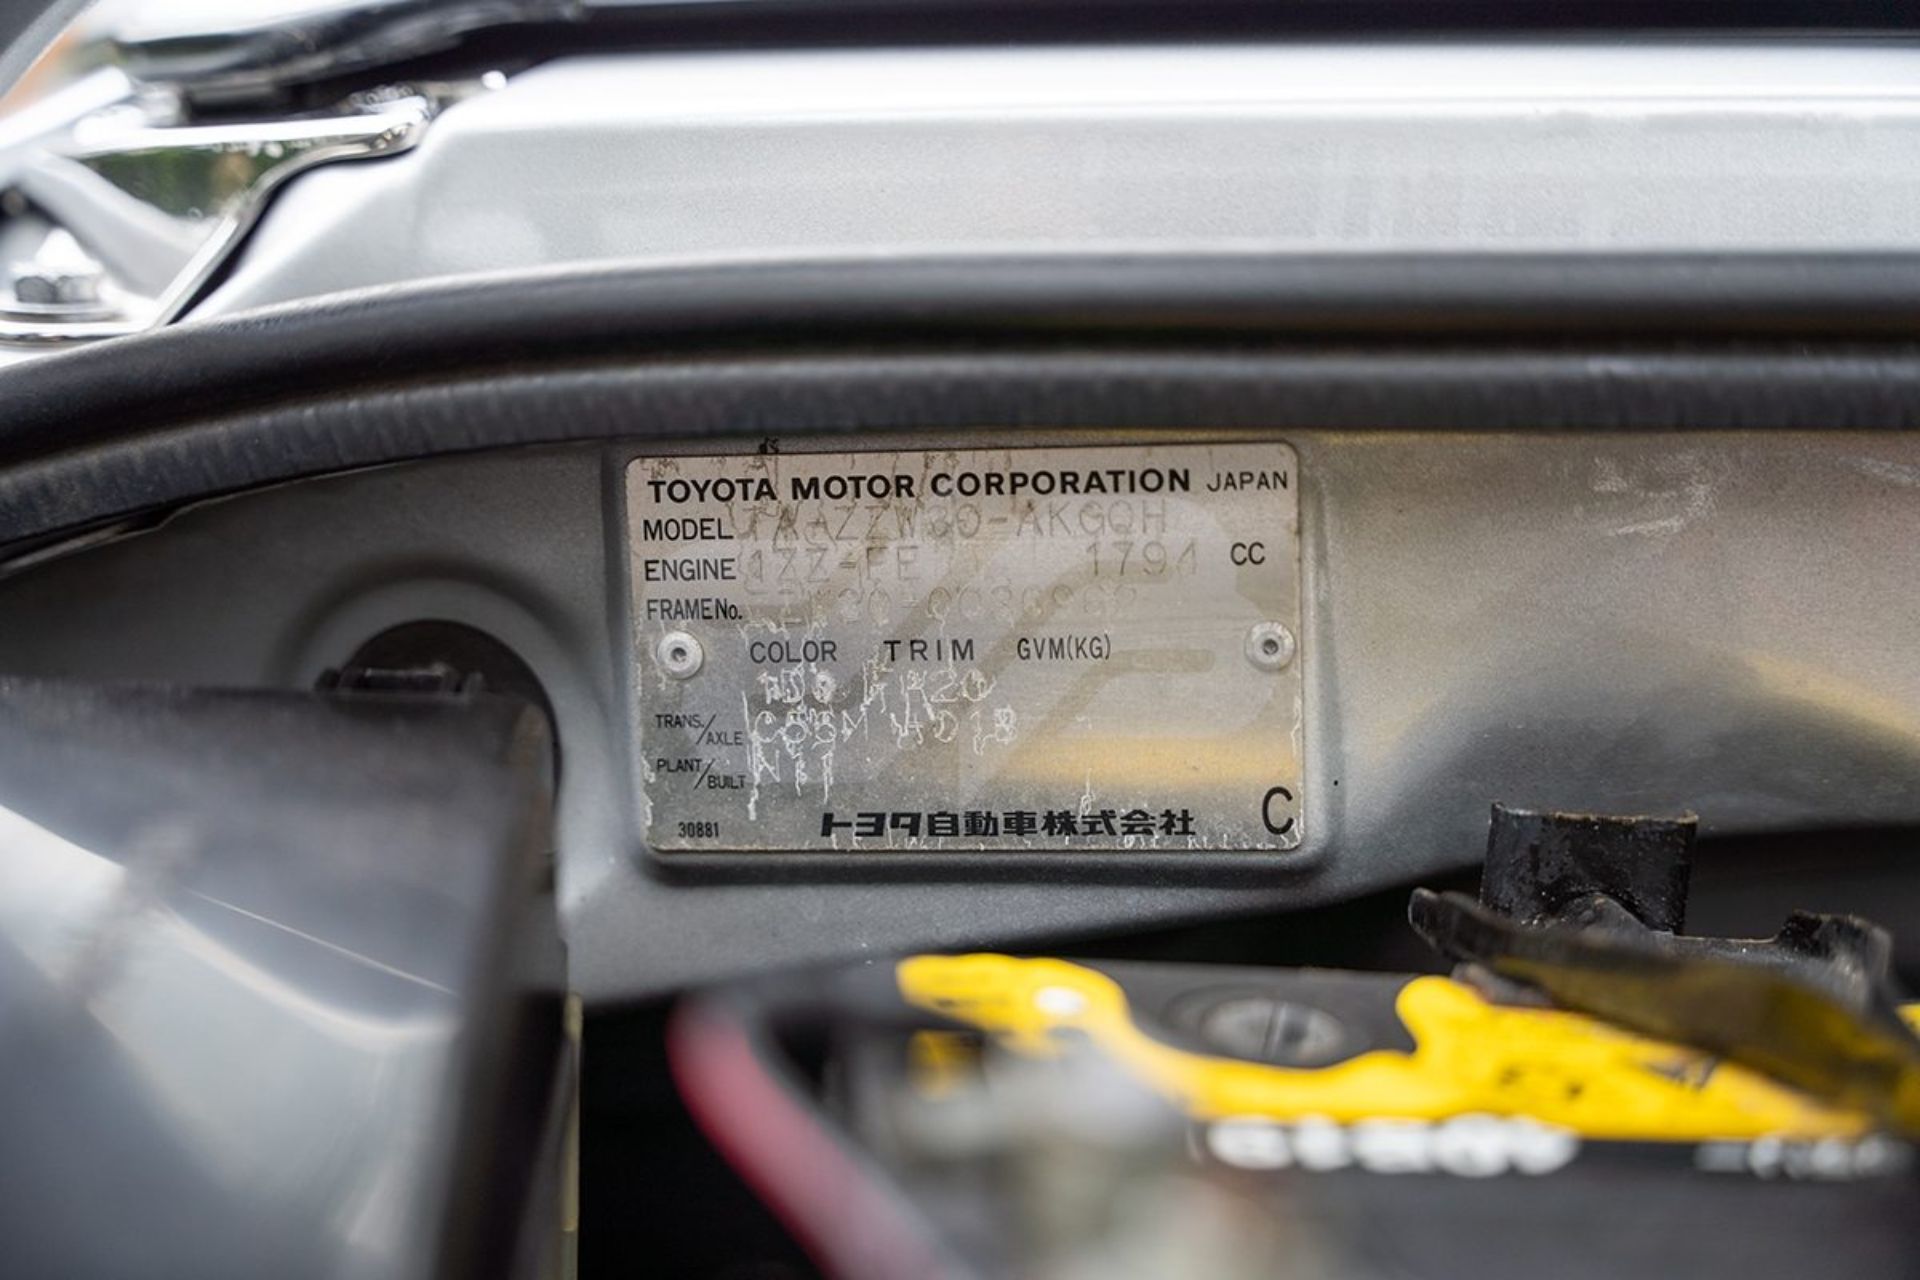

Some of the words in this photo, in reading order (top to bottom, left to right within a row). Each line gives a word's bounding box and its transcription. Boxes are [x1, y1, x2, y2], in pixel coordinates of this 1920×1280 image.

[648, 478, 777, 503] TOYOTA
[791, 475, 915, 500] MOTOR
[931, 469, 1190, 497] CORPORATION
[1207, 471, 1288, 492] JAPAN
[643, 518, 734, 541] MODEL
[645, 558, 736, 582] ENGINE
[1230, 542, 1266, 565] CC
[751, 640, 838, 664] COLOR
[884, 639, 974, 662] TRIM
[1017, 633, 1111, 659] GVM(KG)
[821, 809, 1196, 837] トヨタ自動車株式会社
[1262, 787, 1294, 835] C
[678, 822, 719, 838] 30881
